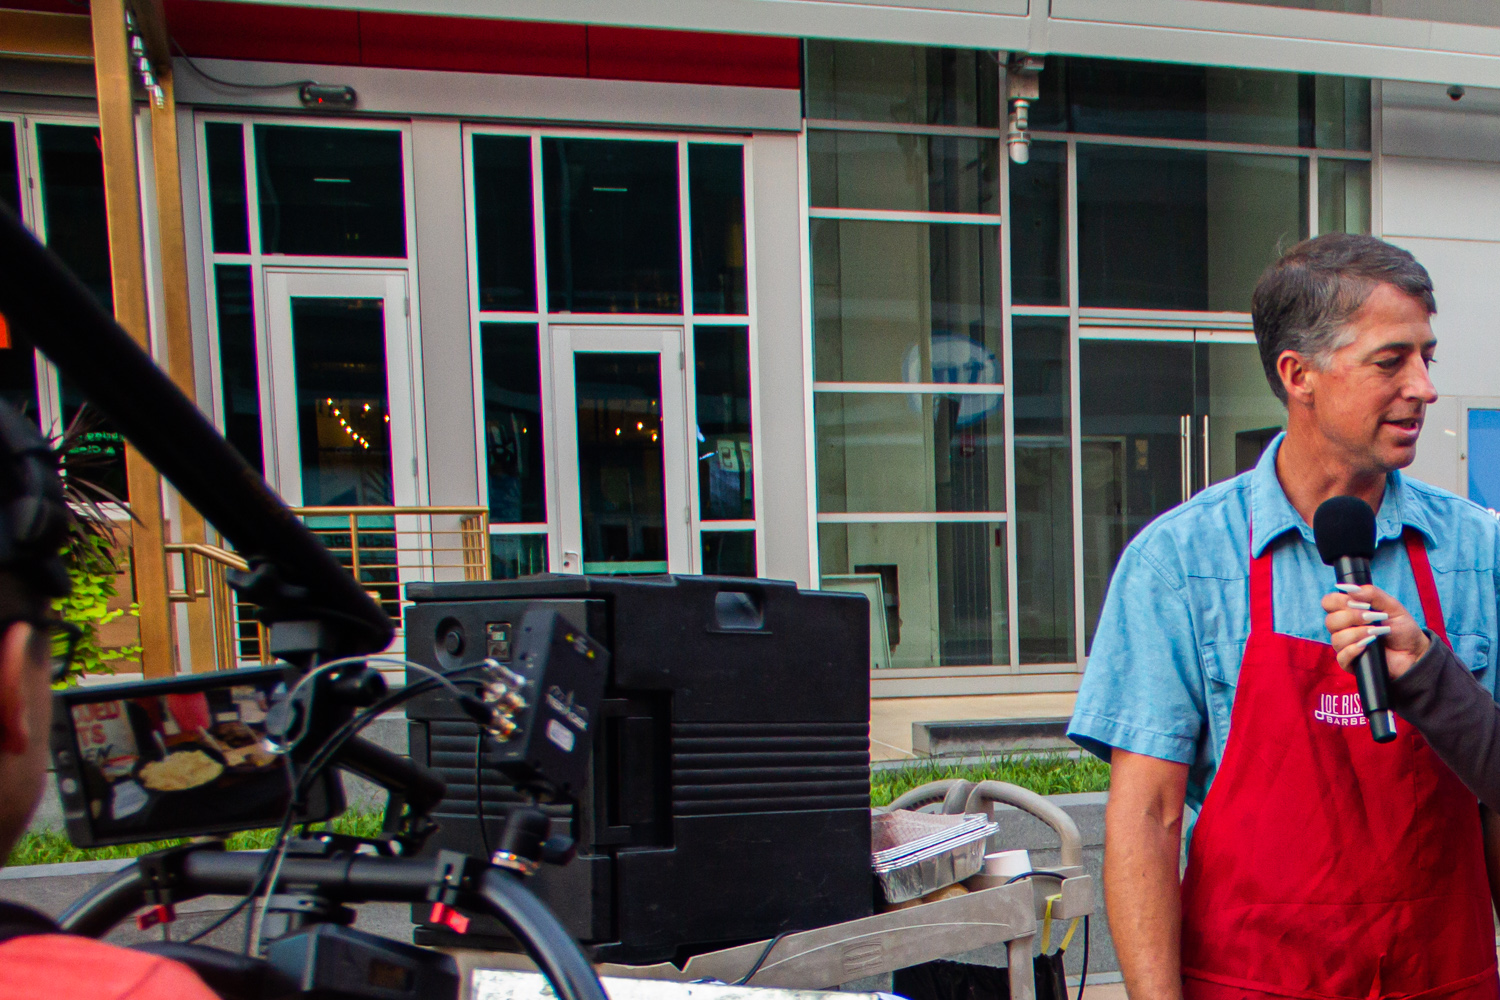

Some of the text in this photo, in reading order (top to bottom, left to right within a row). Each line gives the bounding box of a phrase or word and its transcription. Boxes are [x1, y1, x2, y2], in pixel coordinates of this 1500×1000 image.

[1315, 693, 1363, 720] JOE RIS
[1326, 716, 1370, 726] BARBE
